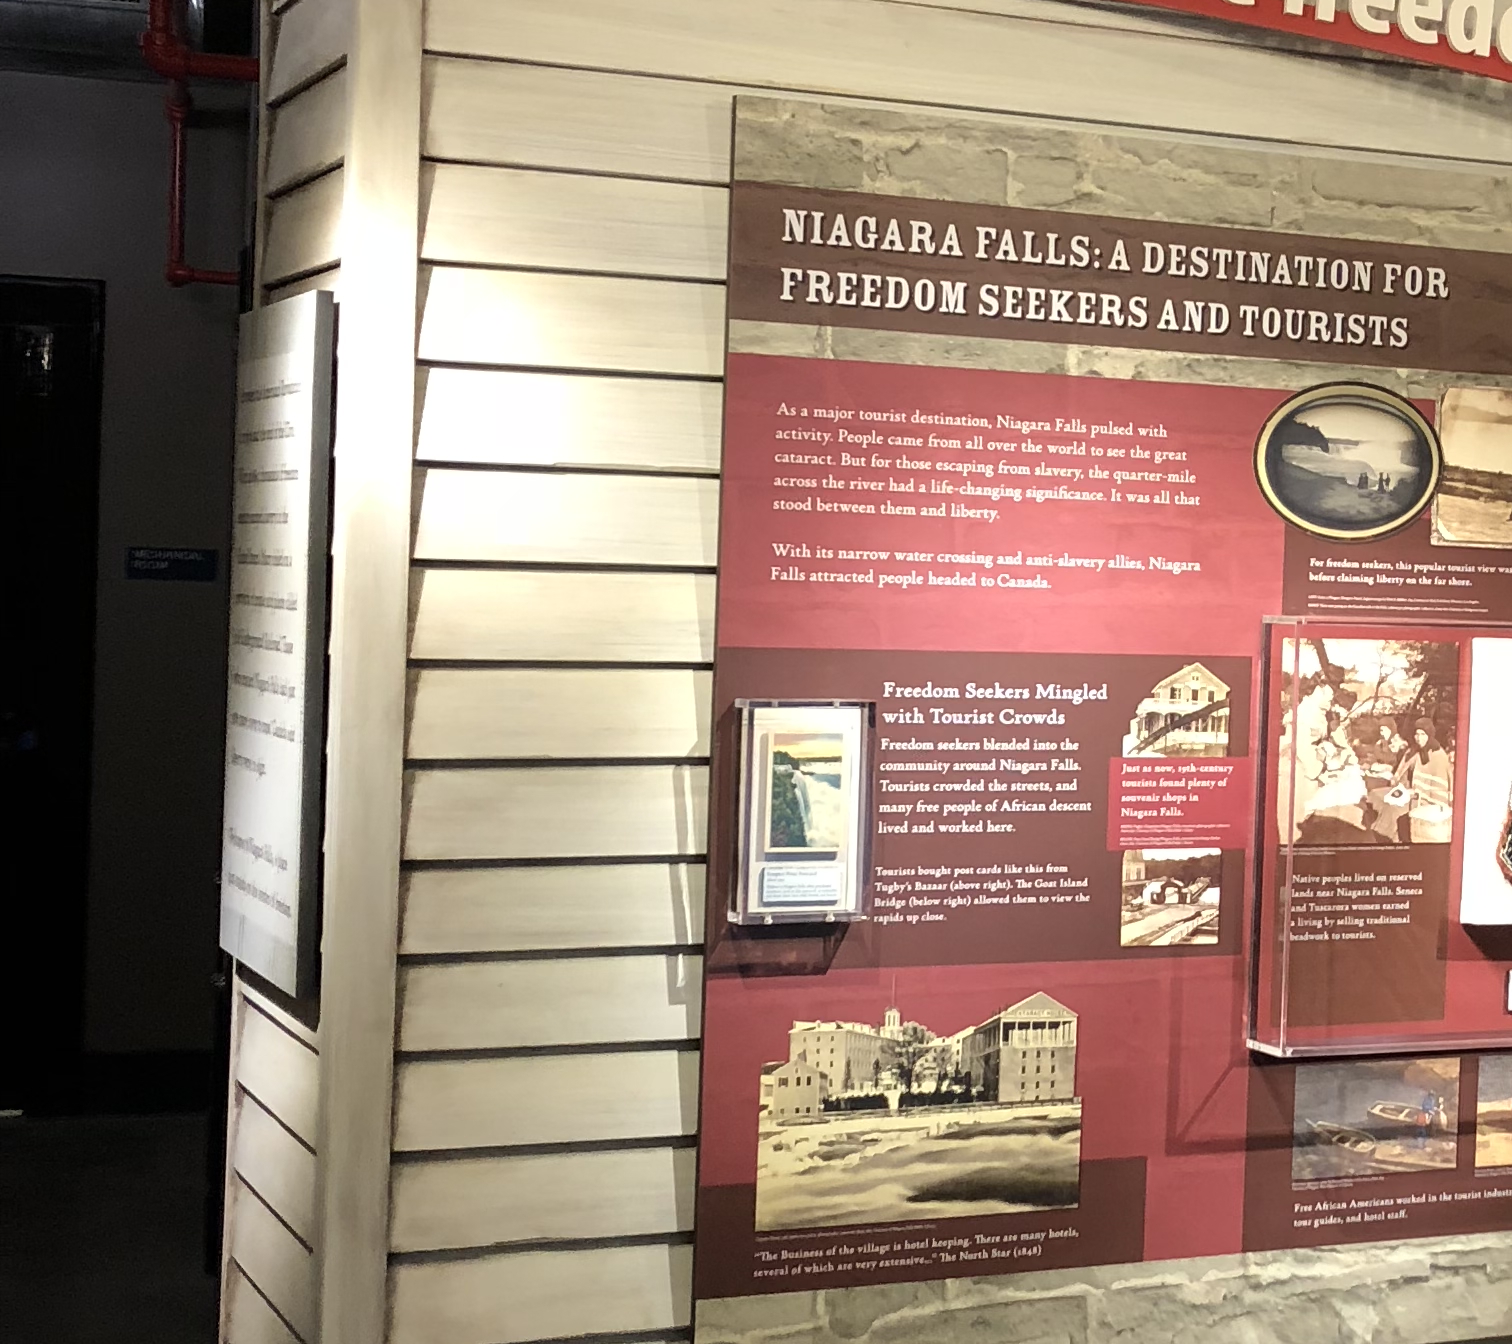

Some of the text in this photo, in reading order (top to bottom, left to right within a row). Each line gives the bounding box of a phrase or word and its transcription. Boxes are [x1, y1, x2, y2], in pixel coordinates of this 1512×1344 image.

[781, 209, 1448, 296] NIAGARA FALLS: A DESTINATION FOR
[780, 269, 1407, 345] FREEDOM SEEKERS AND TOURISTS
[776, 403, 1167, 437] As a major tourist destination, Niagara Falls pulsed with
[775, 428, 1186, 463] activity. People came from all over the world to see the great
[774, 452, 1196, 483] cataract. But for those escaping from slavery, the quarter-mile
[773, 474, 1199, 505] across the river had a life-changing significance. It was all that
[773, 497, 999, 522] stood between them and liberty.
[772, 543, 1200, 574] With its narrow water crossing and anti-slavery allies, Niagara
[771, 567, 1051, 588] Falls attracted people headed to Canada.
[883, 682, 1107, 704] Freedom Seekers Mingled
[882, 708, 1065, 724] with Tourist Crowds
[881, 738, 1078, 750] Freedom seekers blended into the
[879, 758, 1081, 774] community around Niagara Falls.
[1121, 807, 1183, 818] Niagara Falls.
[878, 820, 1015, 833] lived and worked here.
[1291, 885, 1423, 899] lands near Niagara Falls. Seneca
